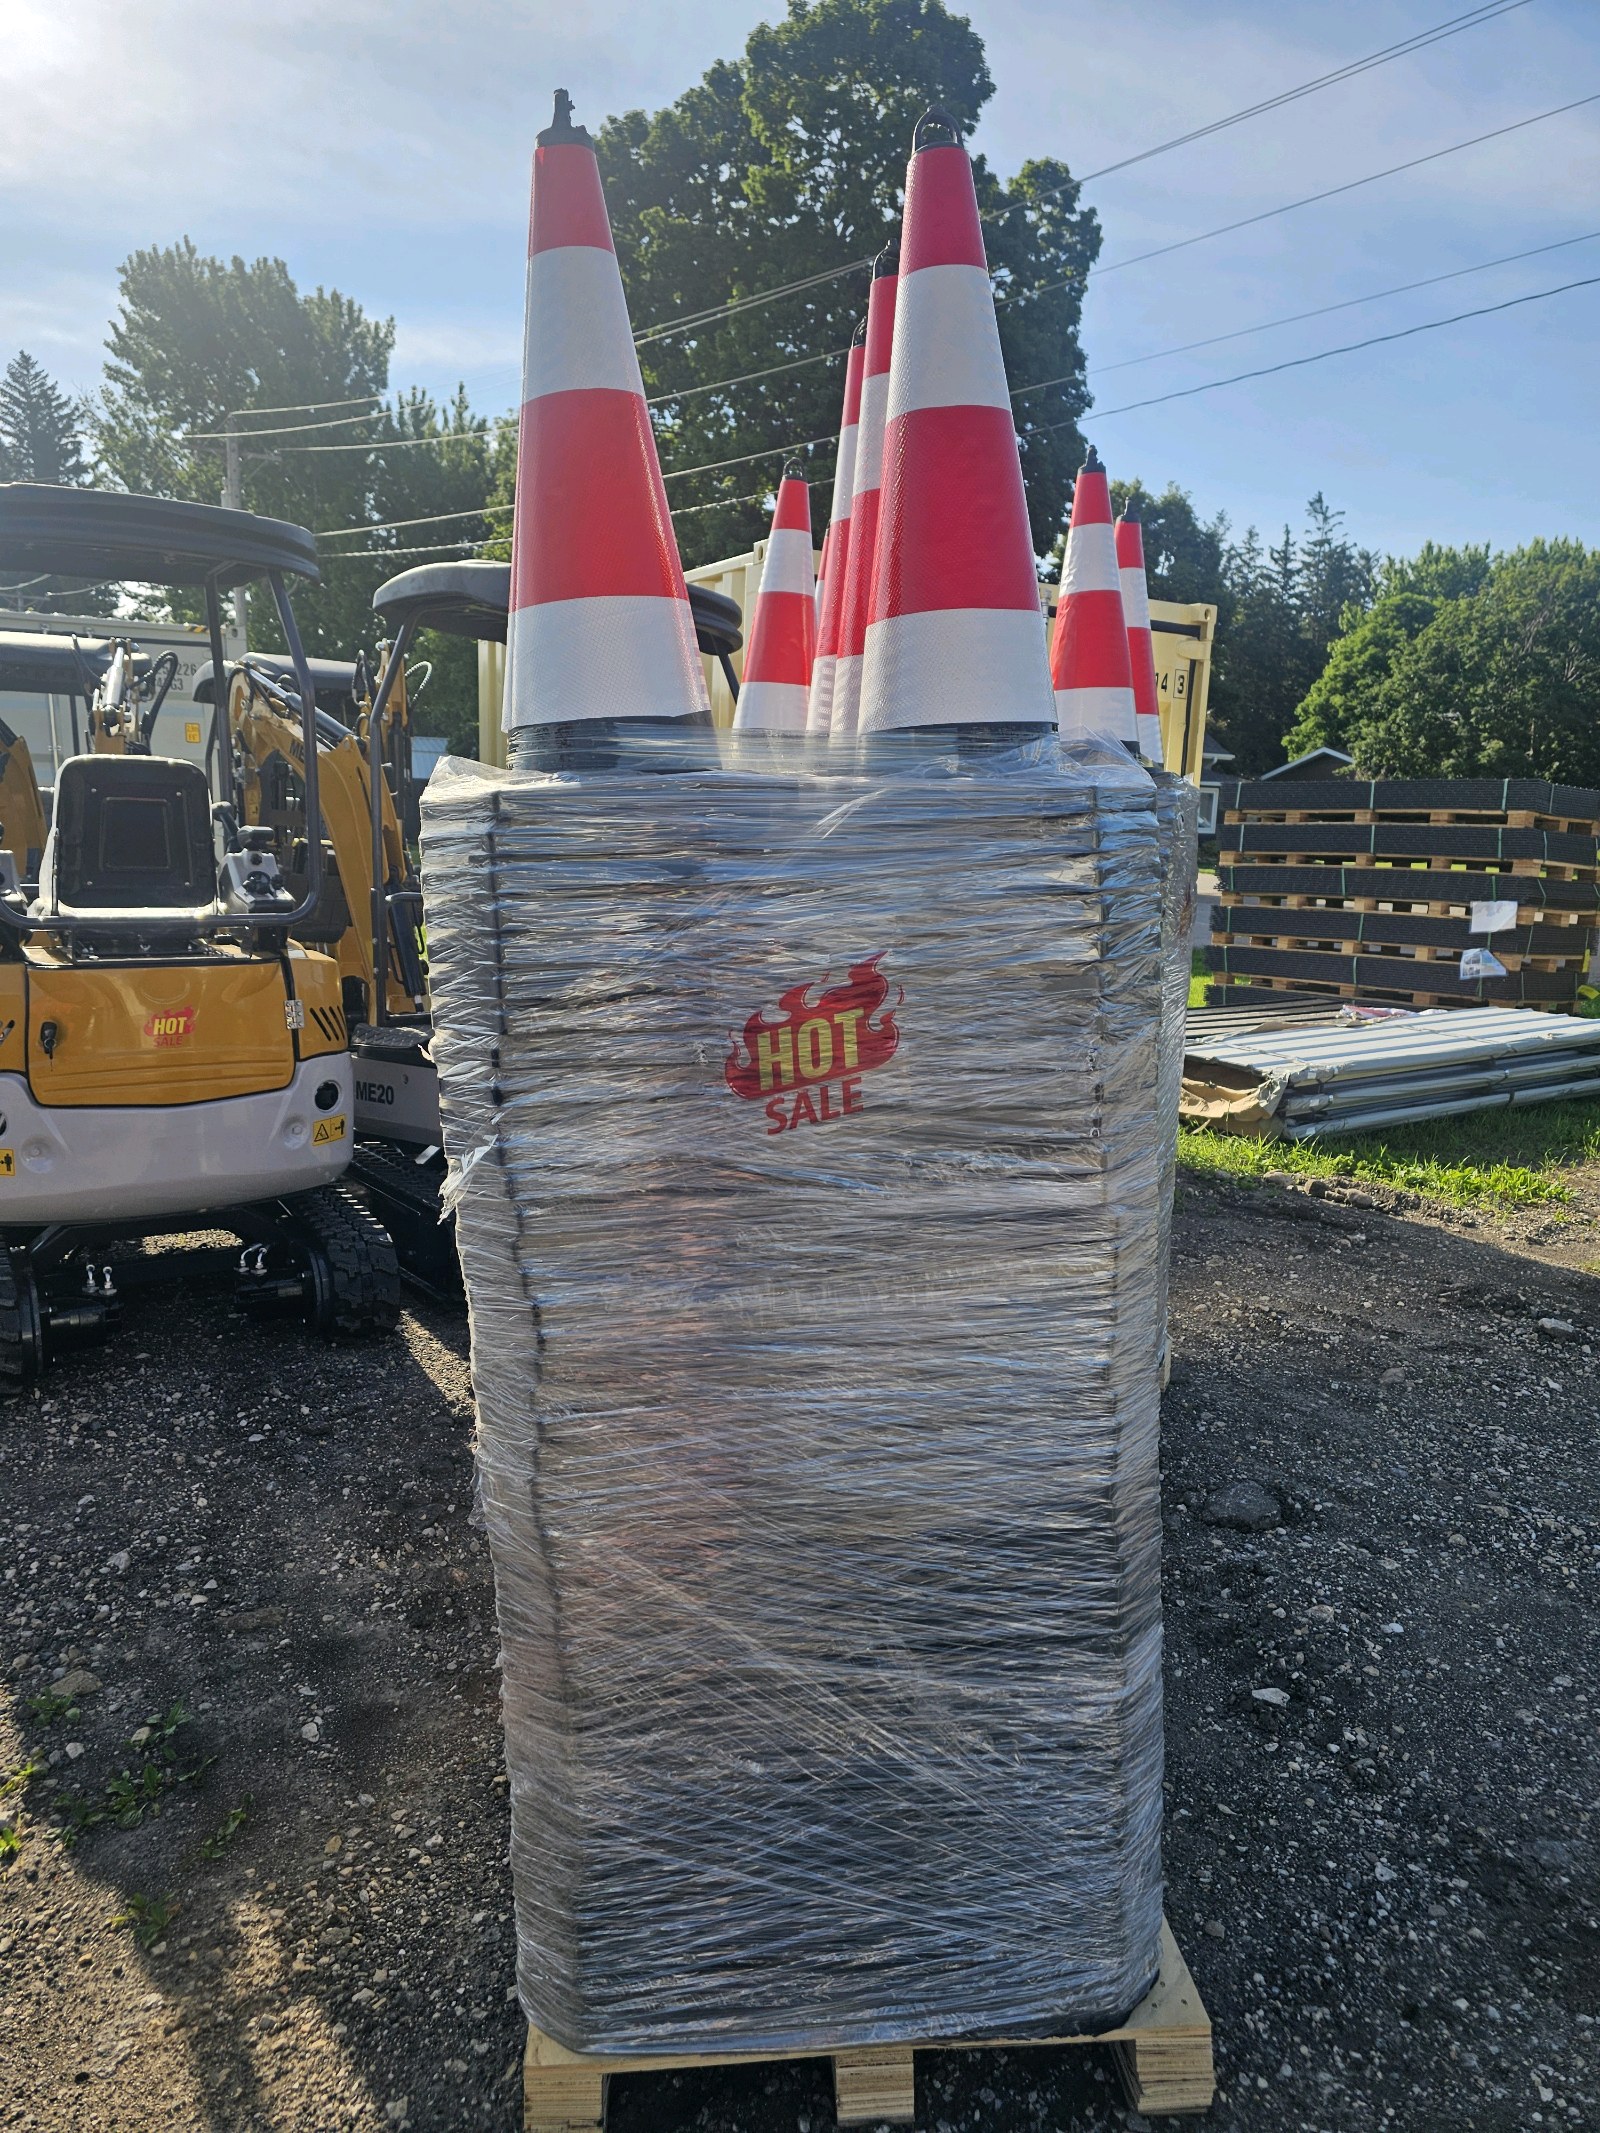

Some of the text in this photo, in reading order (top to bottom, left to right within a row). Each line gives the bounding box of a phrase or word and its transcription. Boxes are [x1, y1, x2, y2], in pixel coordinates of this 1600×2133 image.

[1177, 674, 1185, 694] 3
[153, 1016, 188, 1035] HOT
[153, 1035, 184, 1048] SALE
[757, 1007, 865, 1091] HOT
[355, 1080, 394, 1105] ME20
[765, 1076, 864, 1136] SALE
